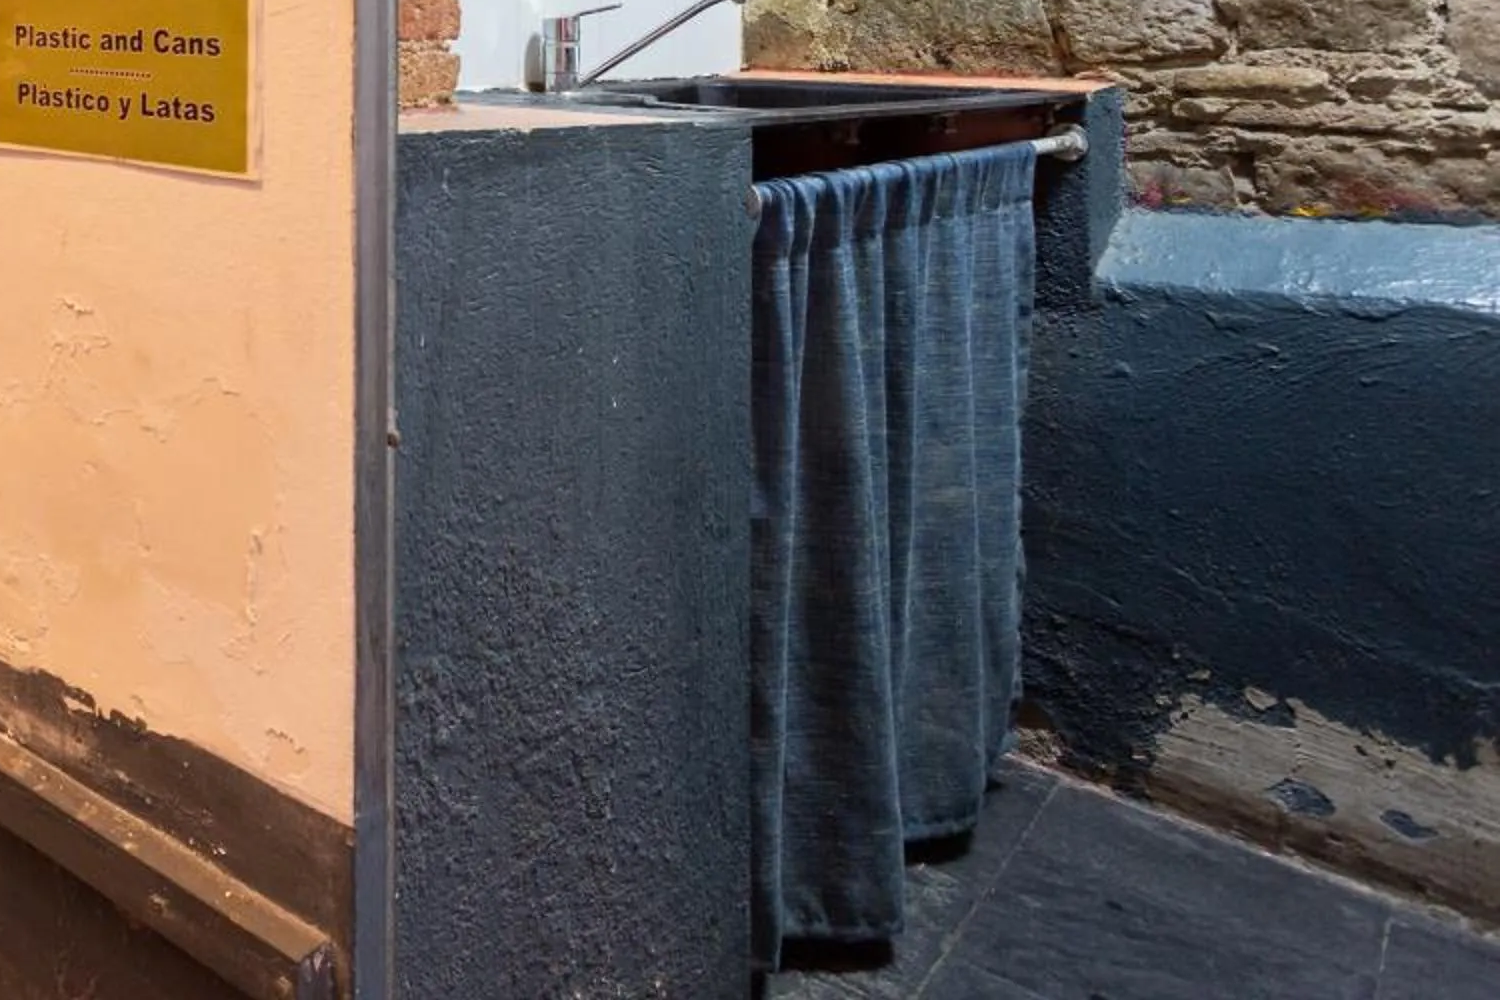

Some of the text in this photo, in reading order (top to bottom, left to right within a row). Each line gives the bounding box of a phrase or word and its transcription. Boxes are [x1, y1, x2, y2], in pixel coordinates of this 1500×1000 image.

[15, 26, 221, 56] Plastic and Cans
[18, 83, 215, 122] Plástico y Latas
